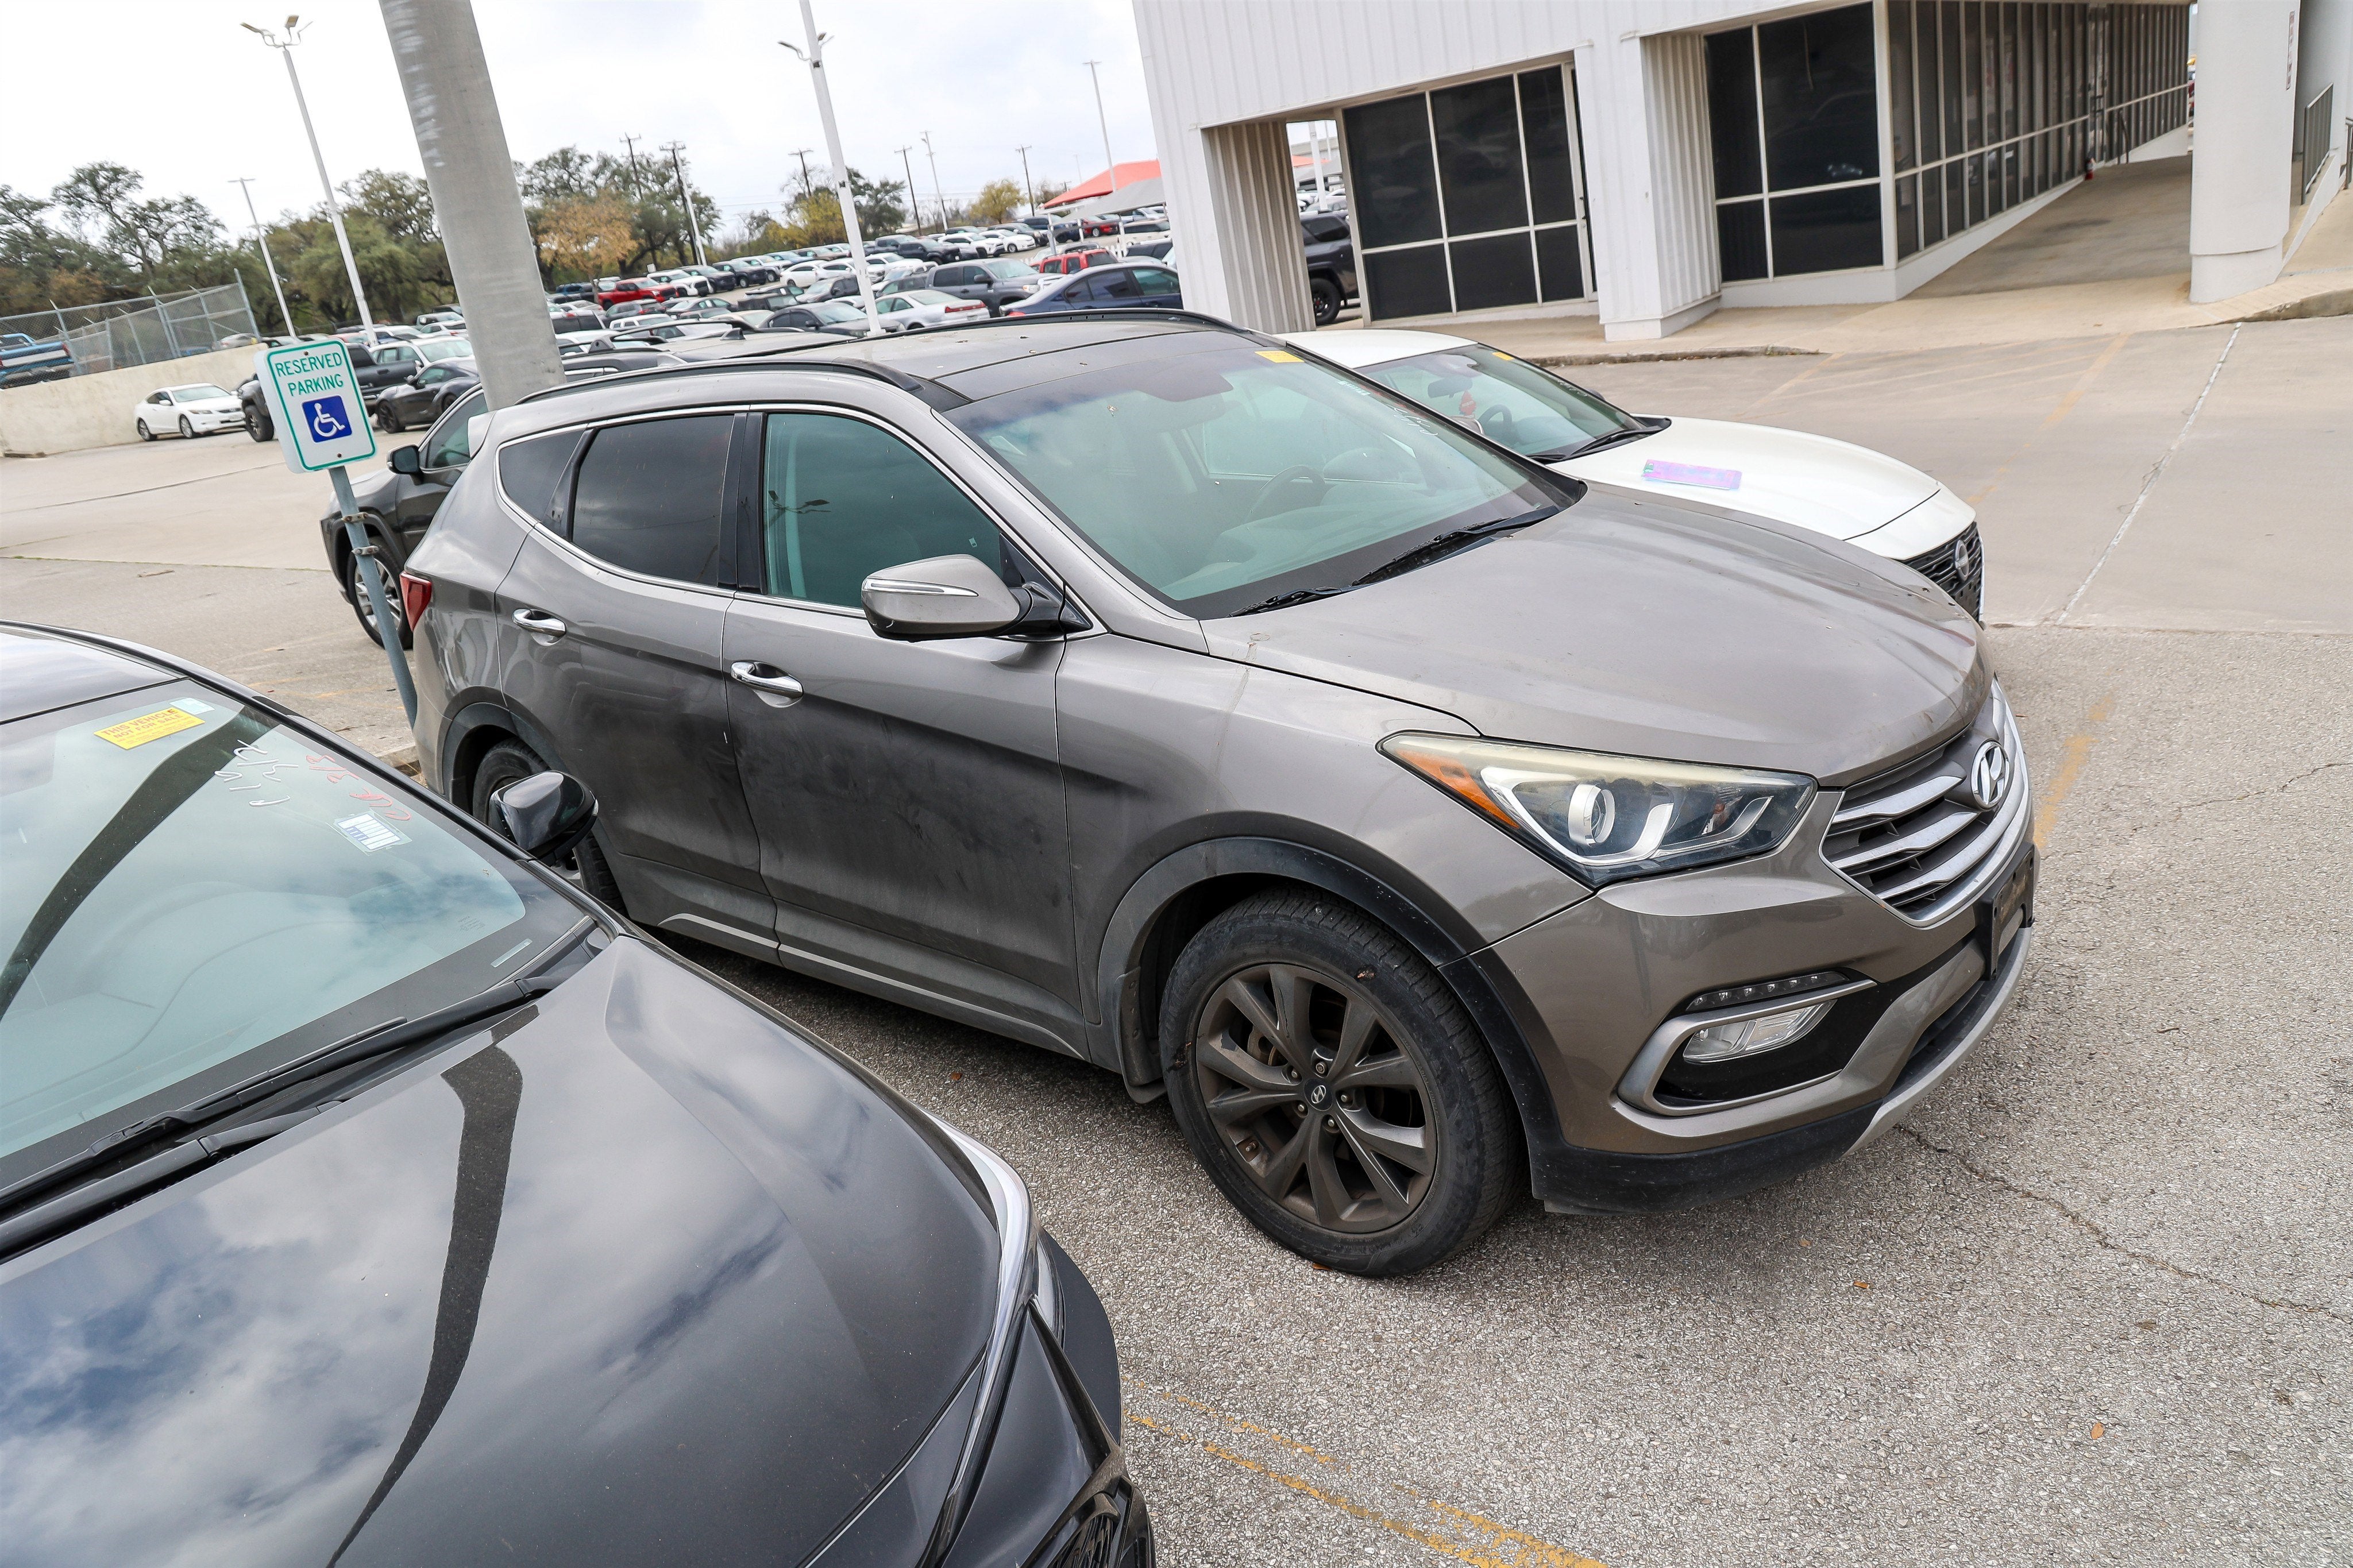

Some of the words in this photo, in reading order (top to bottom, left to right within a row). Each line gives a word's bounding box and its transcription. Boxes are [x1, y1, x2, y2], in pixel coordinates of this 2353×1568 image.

[275, 353, 342, 377] RESERVED
[288, 374, 344, 396] PARKING
[101, 724, 130, 735] THIS
[129, 709, 179, 726] VEHICLE
[113, 730, 134, 739] NOT
[135, 723, 156, 731] FOR
[157, 714, 183, 723] SALE
